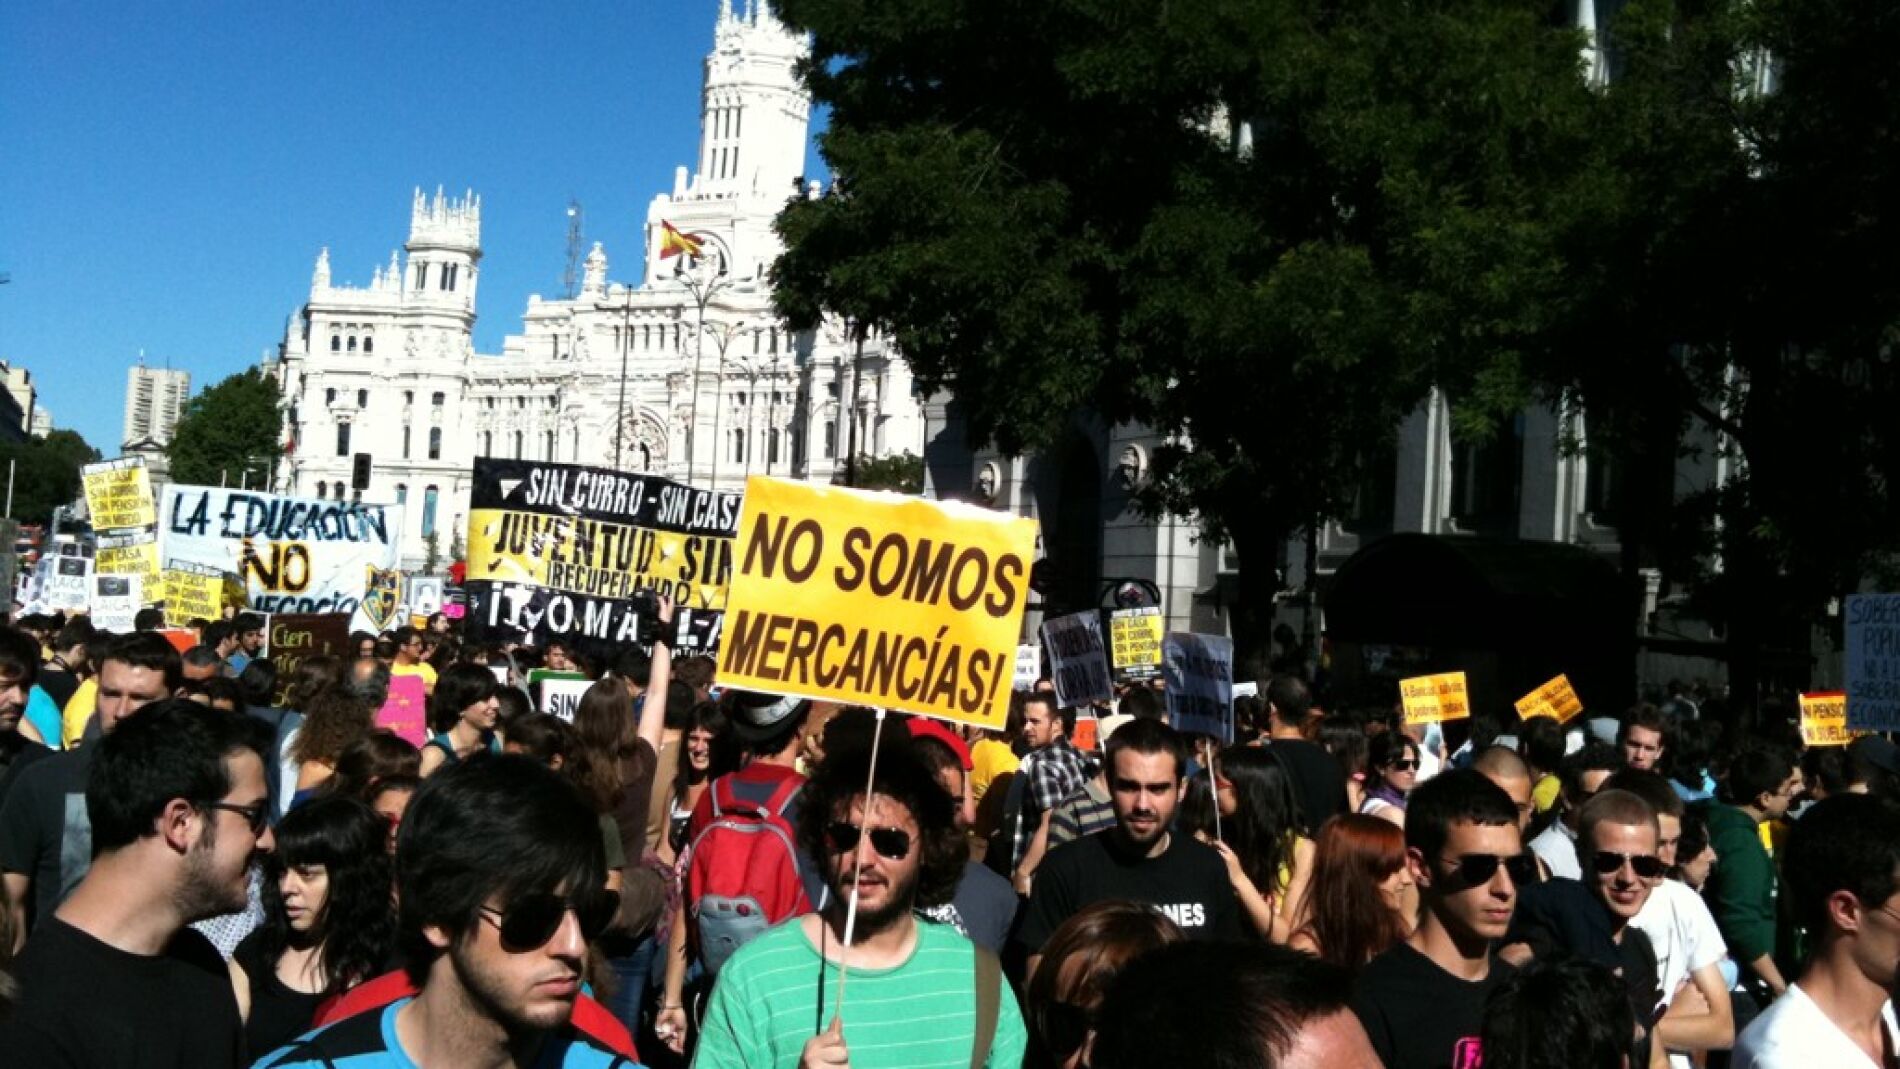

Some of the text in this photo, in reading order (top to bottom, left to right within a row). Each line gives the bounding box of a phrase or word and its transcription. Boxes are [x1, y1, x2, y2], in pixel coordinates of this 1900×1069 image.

[171, 491, 211, 535] LA
[525, 468, 569, 506] SIN
[572, 471, 644, 516] CURRO
[657, 485, 690, 526] SIN
[244, 541, 312, 593] NO
[494, 512, 655, 573] JUVENTUD
[741, 512, 1023, 618] NO SOMOS
[723, 610, 1006, 717] MERCANCÍAS!
[551, 693, 578, 716] SIN
